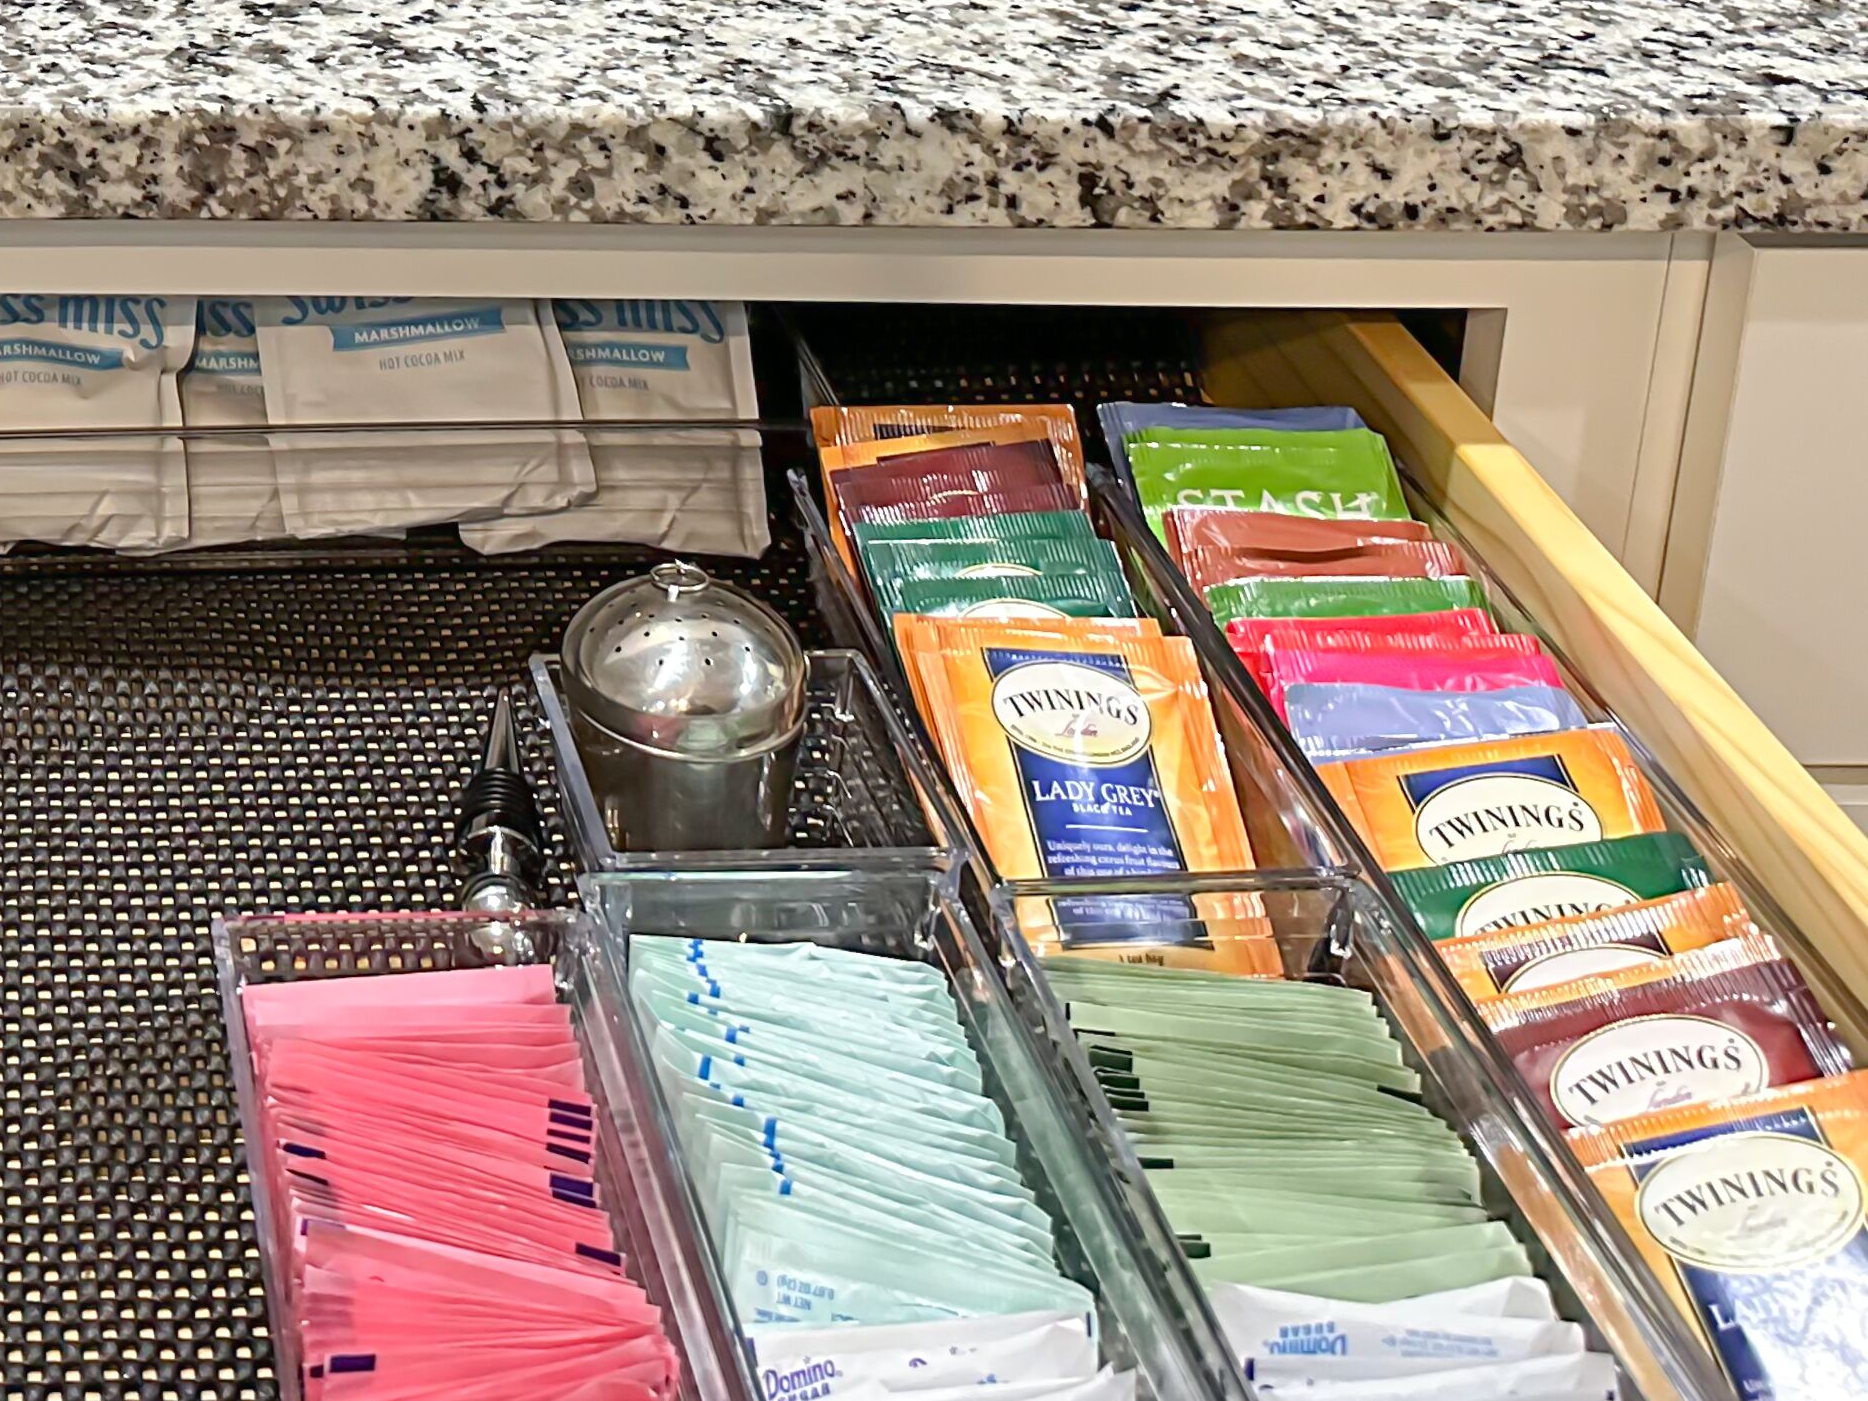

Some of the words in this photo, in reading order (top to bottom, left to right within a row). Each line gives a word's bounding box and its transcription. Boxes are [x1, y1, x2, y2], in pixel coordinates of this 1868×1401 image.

[354, 316, 480, 344] MARSHMALLOW
[379, 357, 400, 370] HOT
[404, 352, 441, 368] COCOA
[443, 349, 465, 363] MIX
[22, 372, 58, 384] COCOA
[61, 373, 82, 386] MIX
[1002, 688, 1139, 726] TWININGS
[1032, 780, 1095, 802] LADY
[1429, 802, 1585, 849] TWININGS
[1568, 1043, 1743, 1107] TWININGS
[1654, 1166, 1840, 1228] TWININGS
[763, 1359, 836, 1400] Domino
